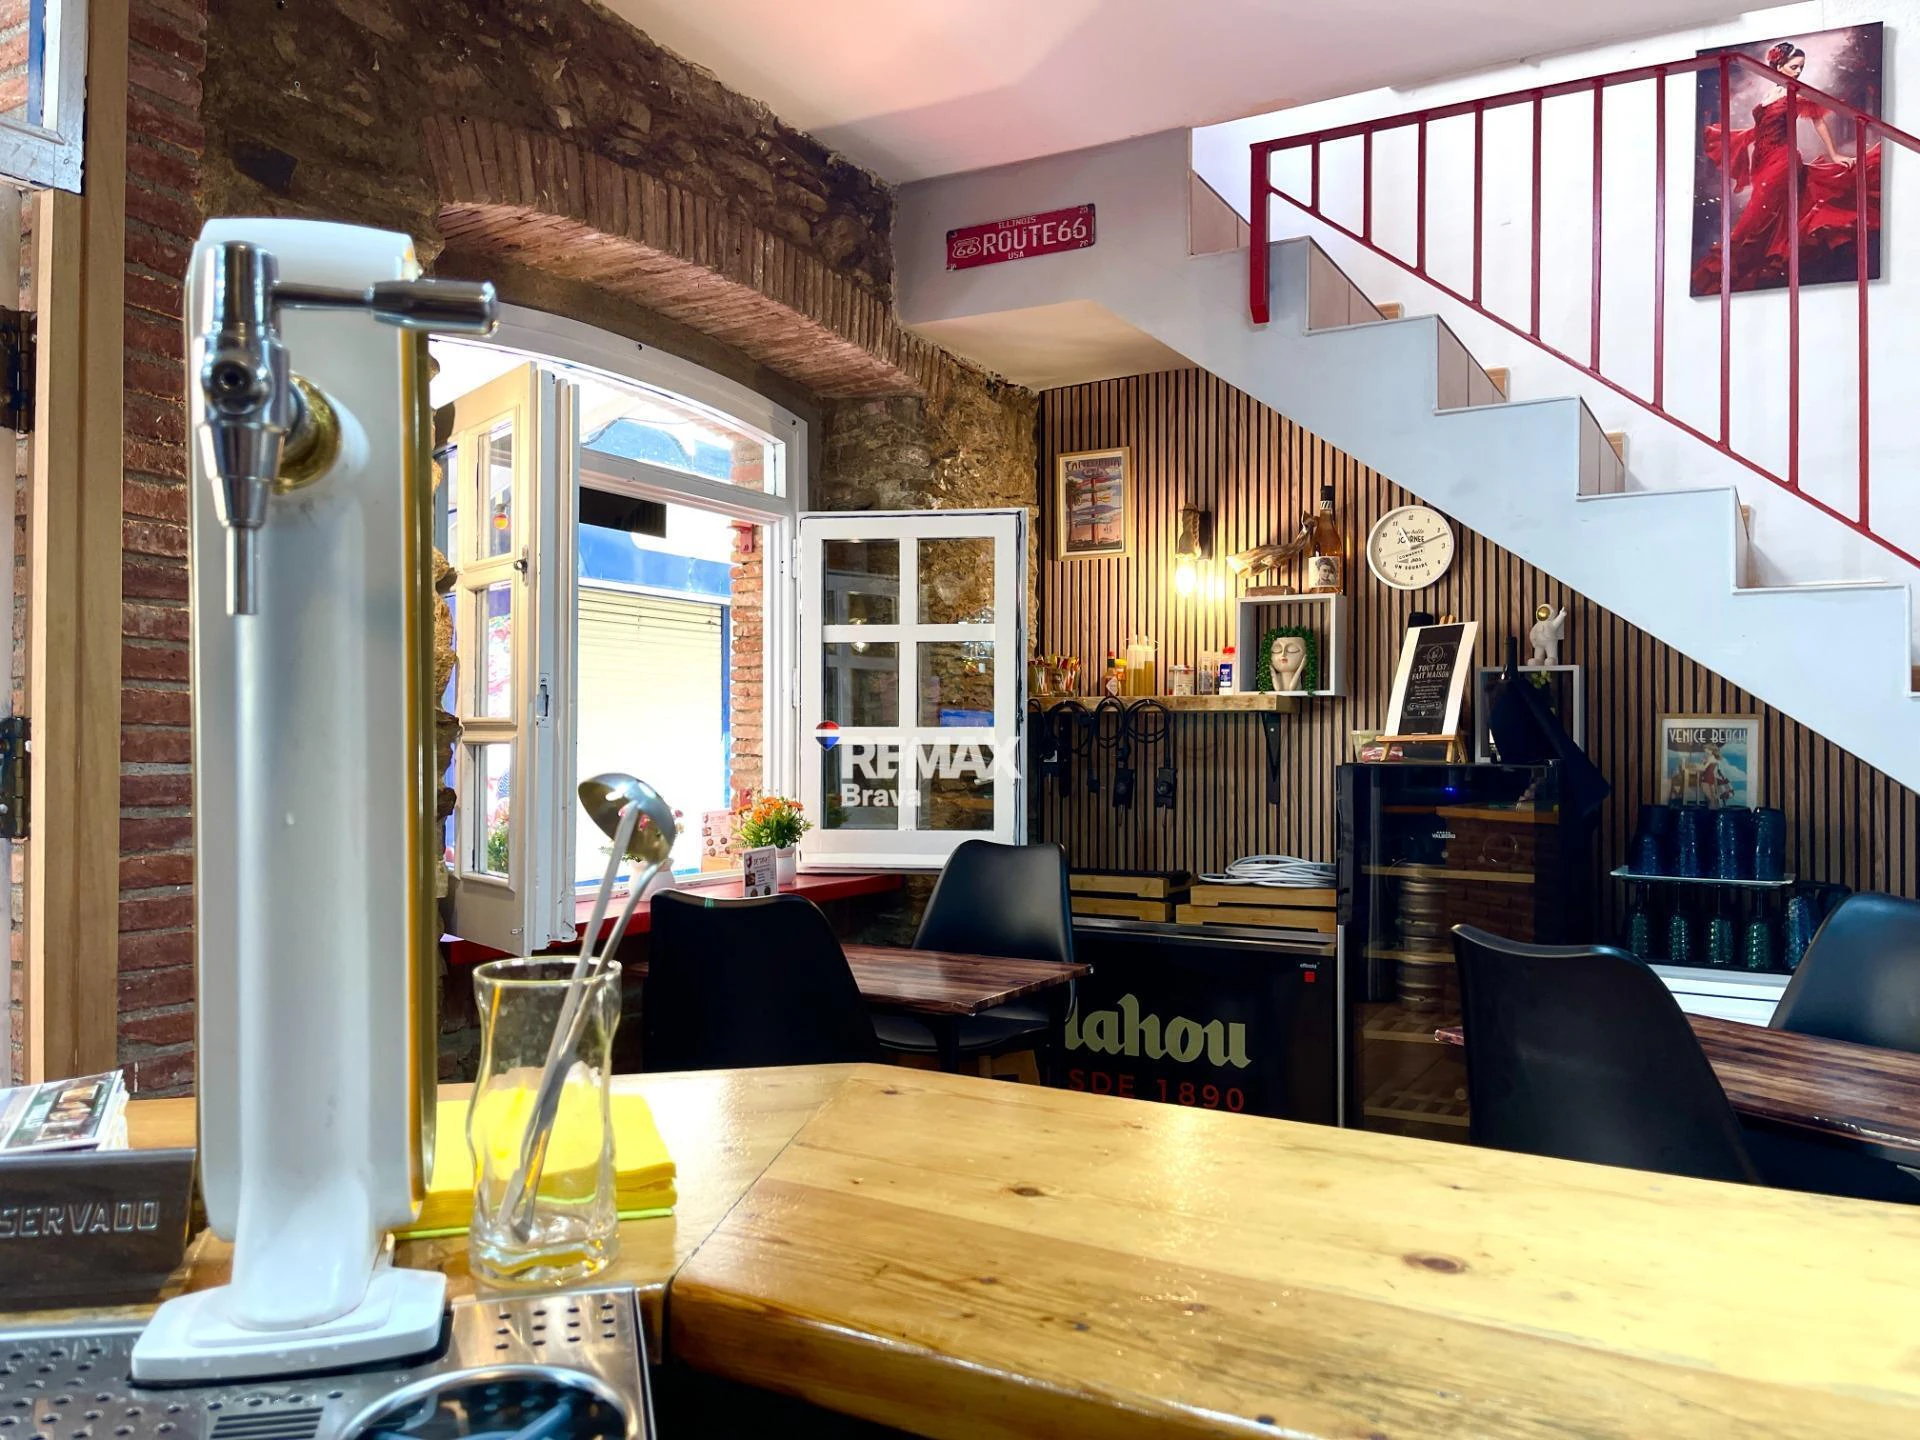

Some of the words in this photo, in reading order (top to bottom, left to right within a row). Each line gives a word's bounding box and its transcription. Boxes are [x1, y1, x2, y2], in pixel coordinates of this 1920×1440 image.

[998, 215, 1037, 230] ILLINOIS
[956, 245, 977, 256] 66
[1008, 251, 1025, 260] USA
[1419, 664, 1435, 672] TOUT
[1412, 671, 1426, 680] FAIT
[1426, 670, 1449, 678] MAISON
[1669, 728, 1707, 743] VENICE
[1710, 728, 1747, 743] BEACH
[1156, 1079, 1245, 1112] 1890
